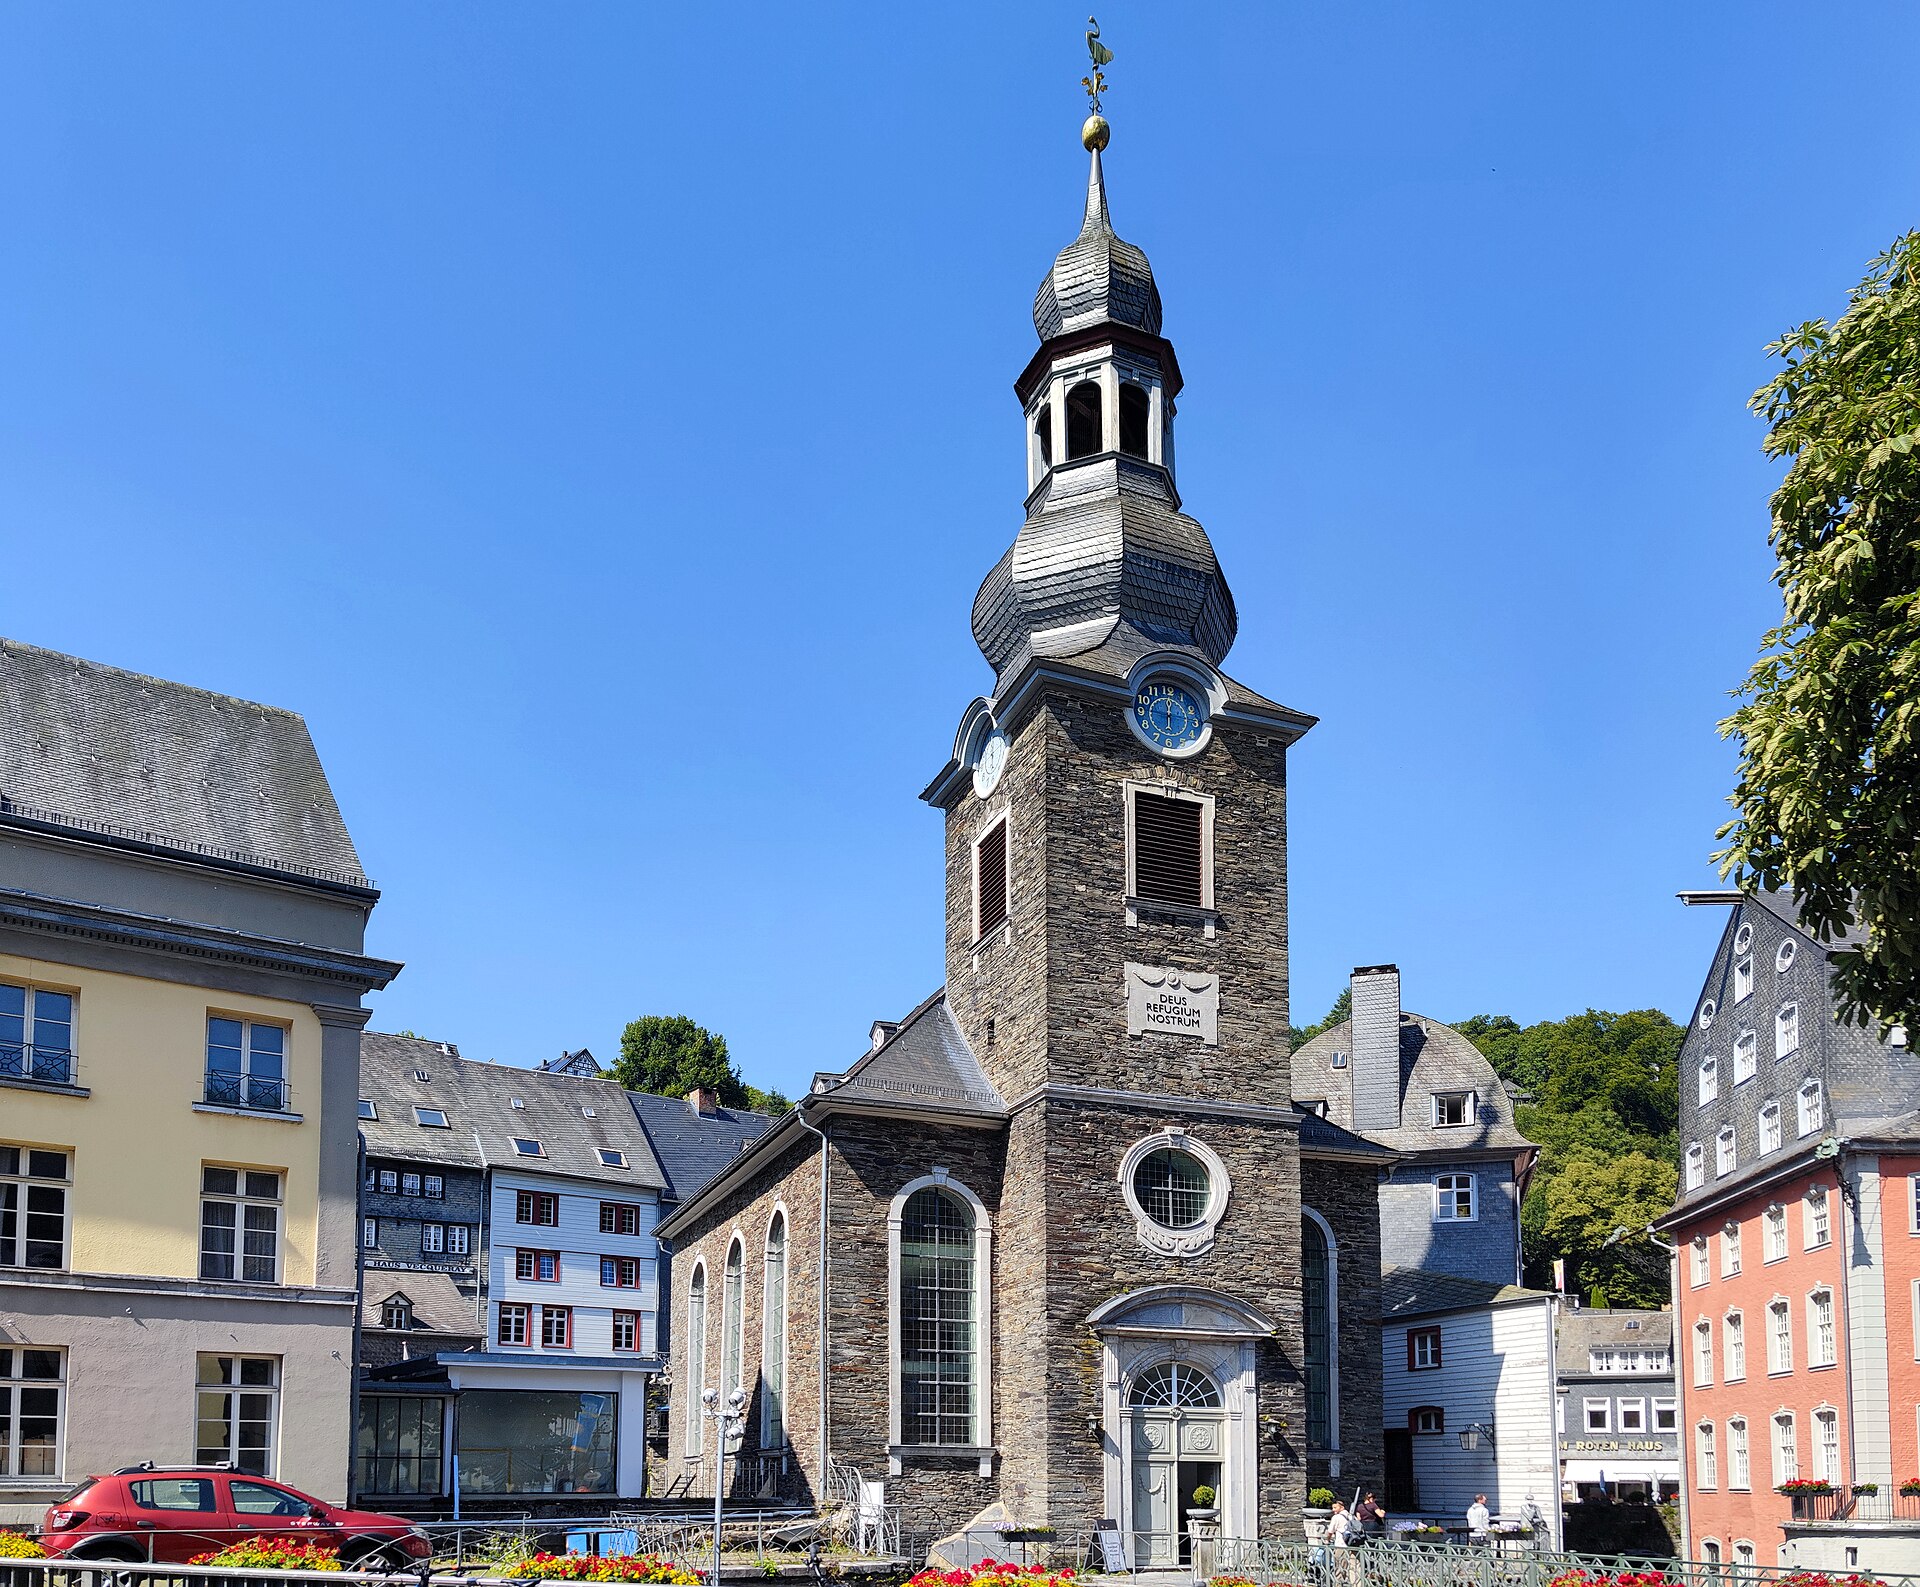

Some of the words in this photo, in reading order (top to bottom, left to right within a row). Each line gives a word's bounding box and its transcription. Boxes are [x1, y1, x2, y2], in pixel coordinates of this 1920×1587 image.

[1148, 685, 1158, 696] 11
[1162, 685, 1174, 696] 12
[1137, 694, 1150, 705] 10
[1179, 692, 1184, 702] 1
[1137, 707, 1145, 716] 9
[1188, 705, 1195, 715] 2
[1141, 719, 1149, 729] 8
[1192, 718, 1199, 728] 3
[1153, 732, 1160, 742] 7
[1188, 729, 1195, 739] 4
[1165, 738, 1173, 748] 6
[1179, 738, 1186, 748] 5
[1159, 994, 1187, 1006] DEUS
[1146, 1003, 1201, 1018] REFUGIUM
[1147, 1014, 1200, 1028] NOSTRUM
[373, 1260, 401, 1268] HAUS
[406, 1263, 466, 1273] VECQUERAY
[1575, 1441, 1619, 1451] ROTEN
[1628, 1441, 1663, 1451] HAUS
